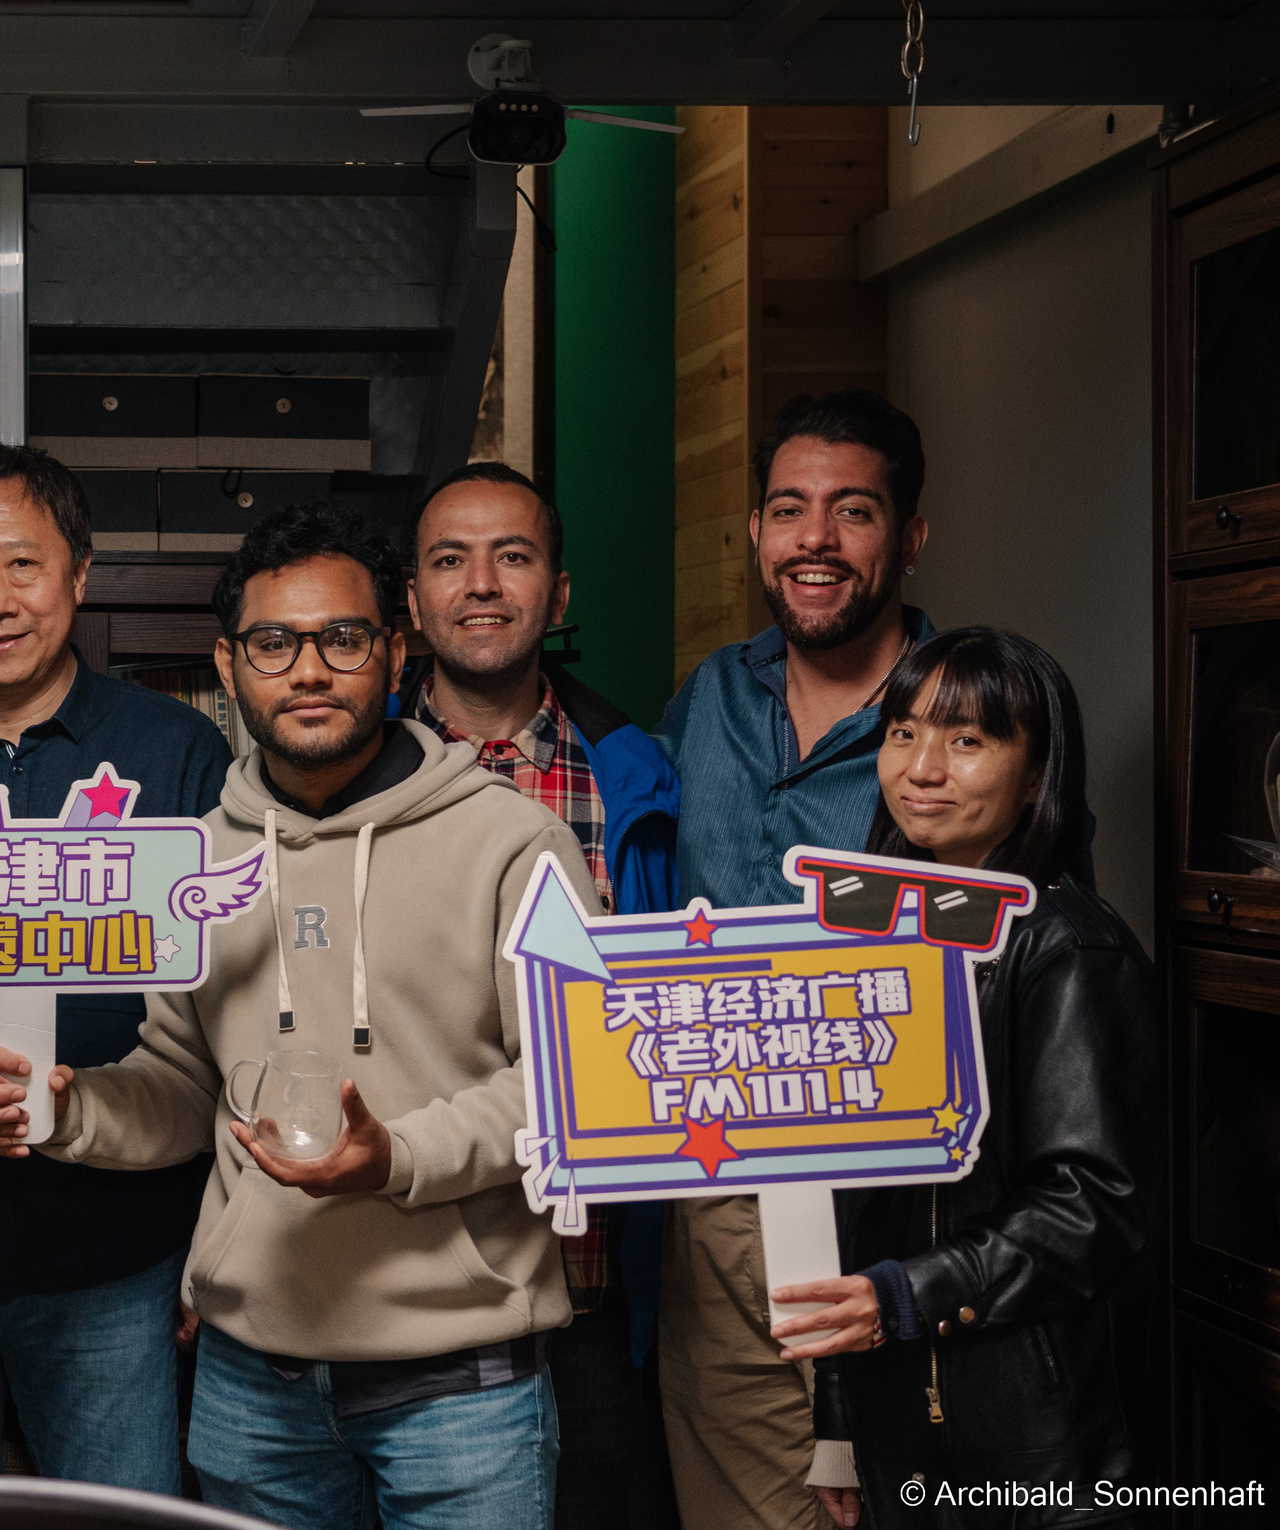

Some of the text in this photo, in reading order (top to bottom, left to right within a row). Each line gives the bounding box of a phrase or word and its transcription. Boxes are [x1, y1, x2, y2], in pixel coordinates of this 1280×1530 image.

[292, 904, 331, 950] R
[604, 967, 912, 1032] 天津经济广播
[628, 1018, 898, 1079] 《老外视线》
[650, 1066, 884, 1123] FM101.4
